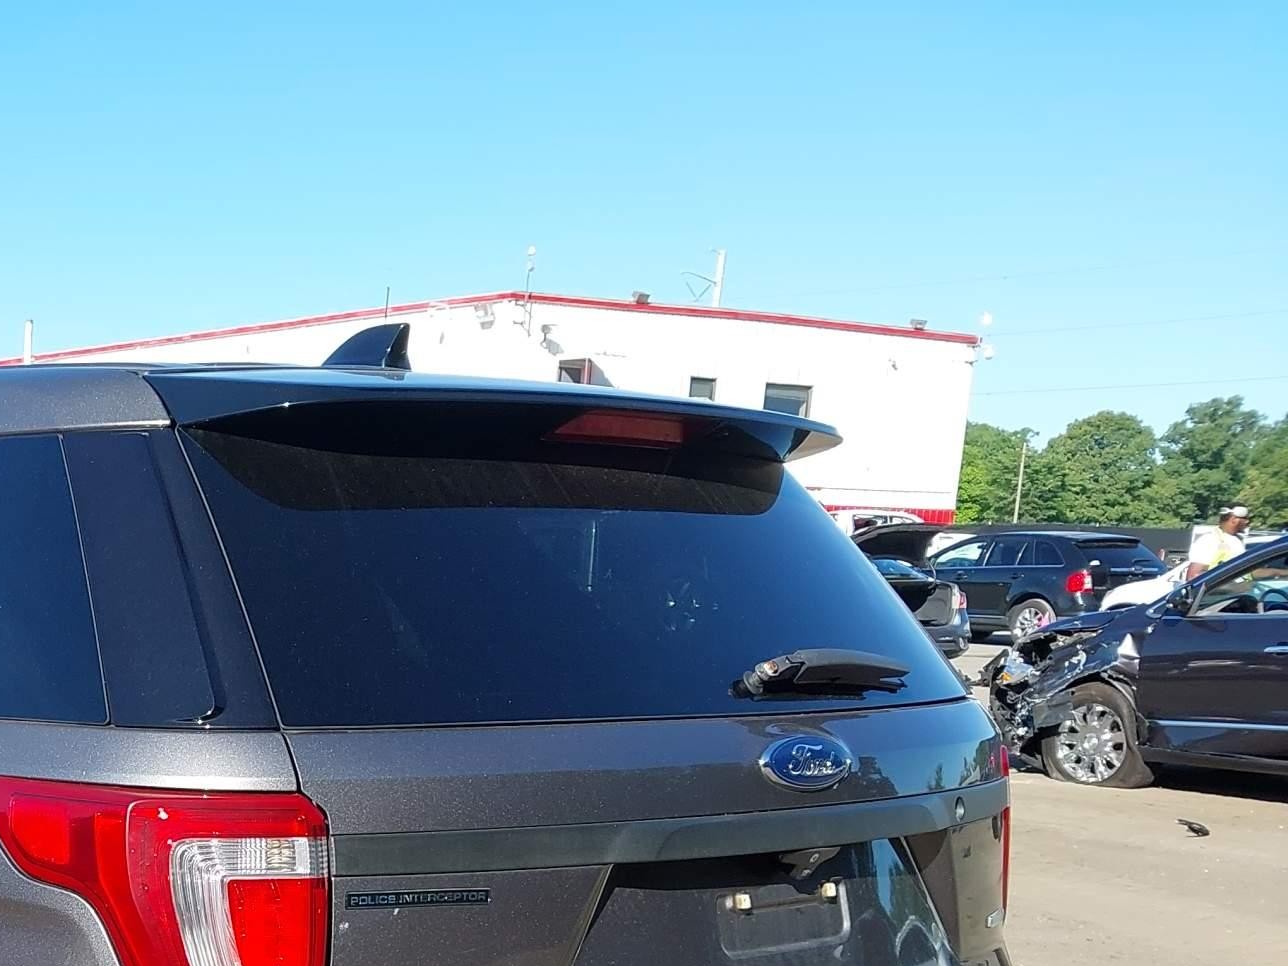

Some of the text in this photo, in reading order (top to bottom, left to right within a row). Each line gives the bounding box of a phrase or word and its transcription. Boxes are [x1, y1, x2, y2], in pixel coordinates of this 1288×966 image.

[788, 743, 842, 775] Ford
[349, 890, 487, 907] POLICE INTERCEPTOR
